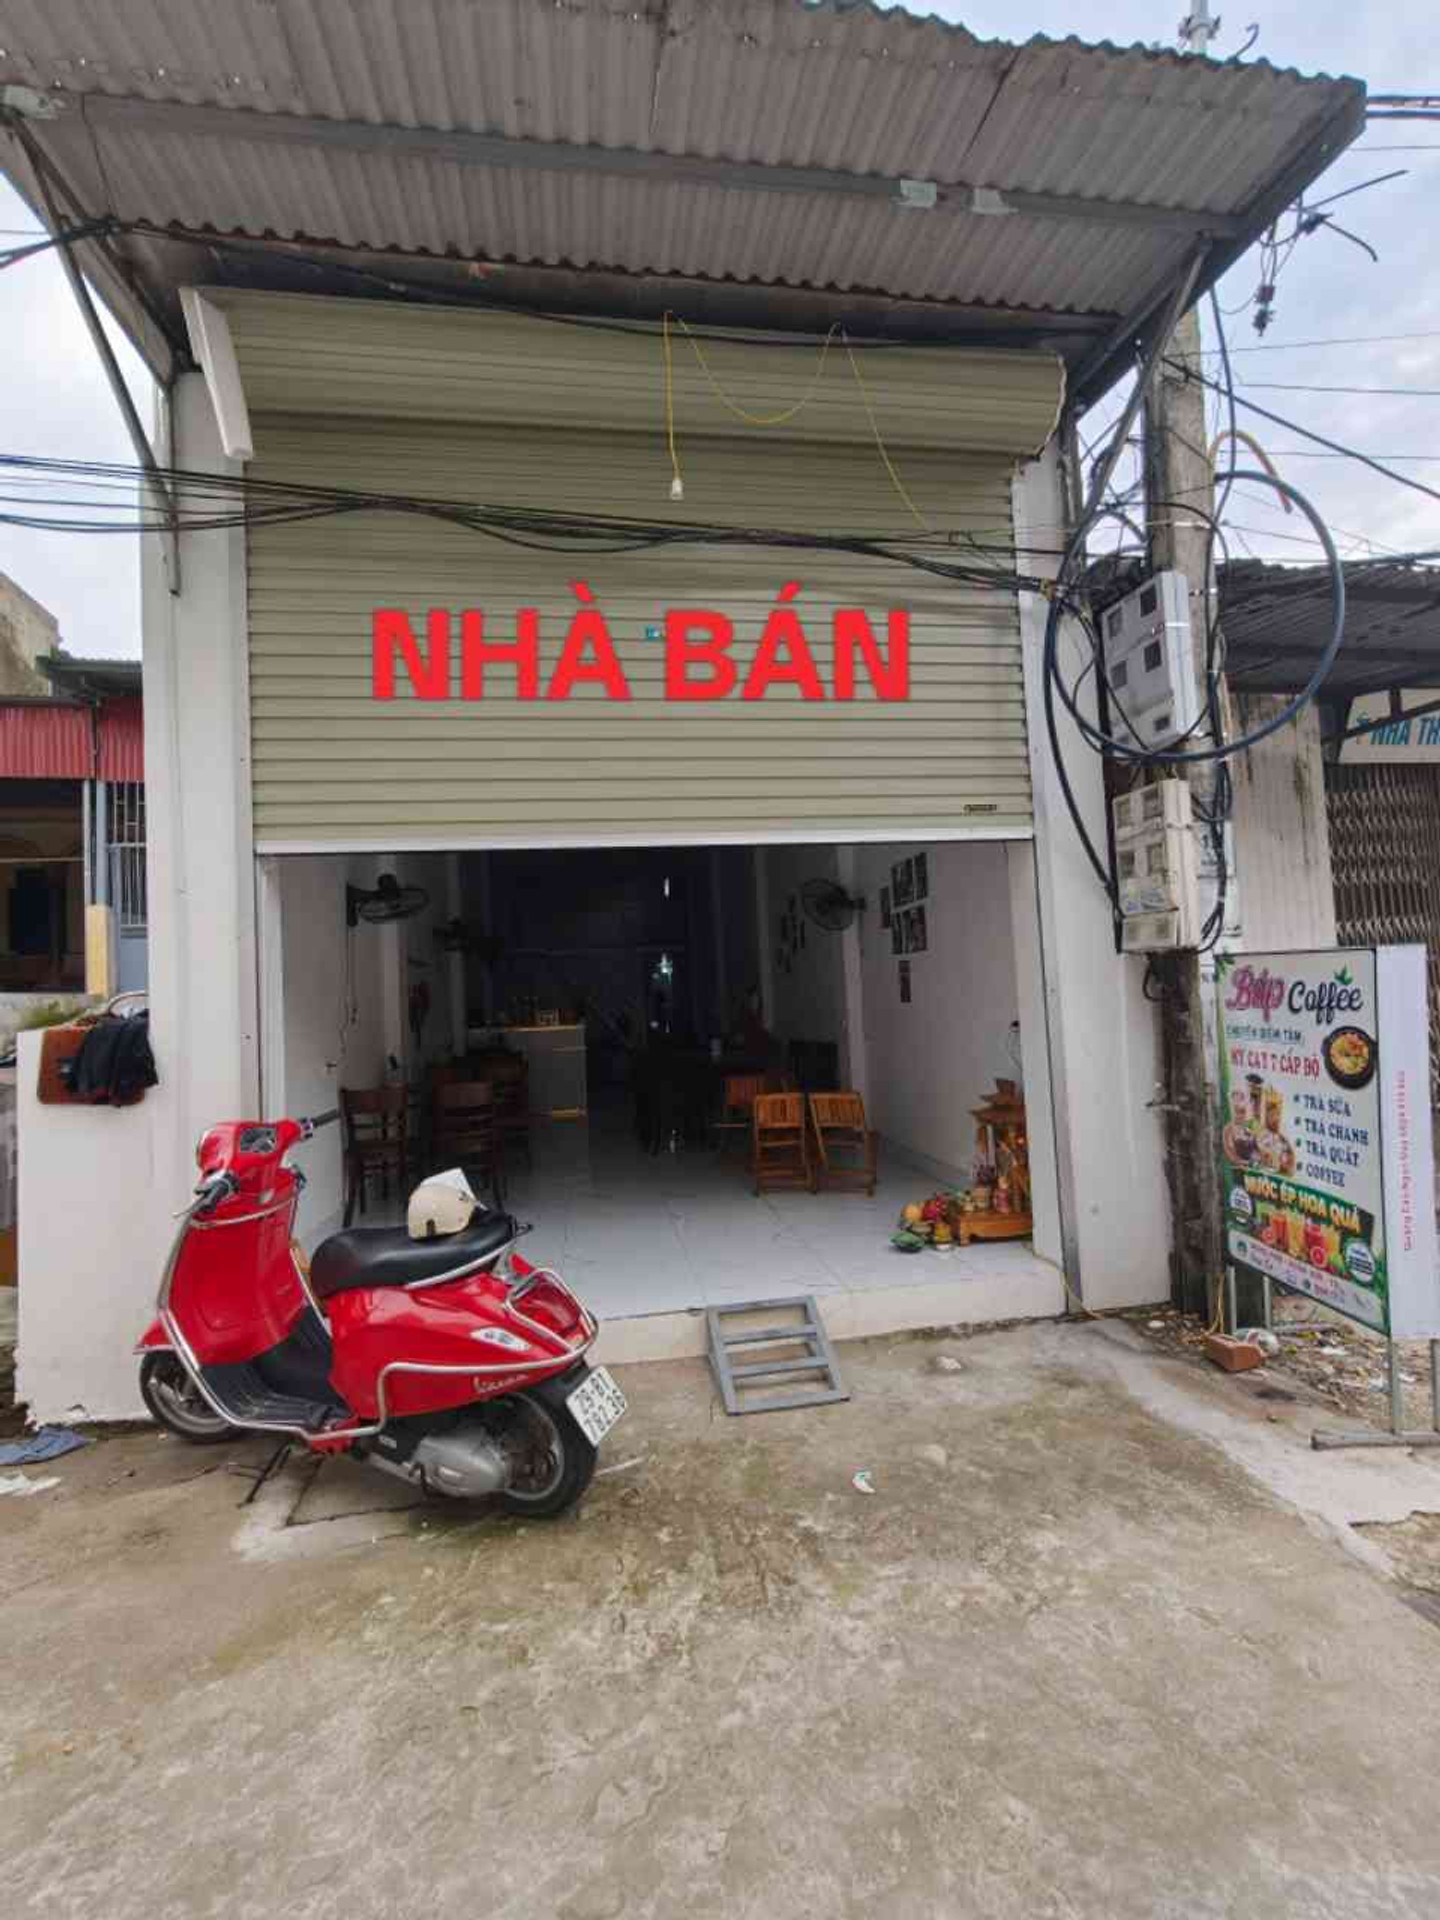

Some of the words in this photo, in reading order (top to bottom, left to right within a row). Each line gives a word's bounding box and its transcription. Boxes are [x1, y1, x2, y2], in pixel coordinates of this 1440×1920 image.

[1288, 980, 1364, 1025] Coffee
[1328, 1122, 1369, 1146] CHANH
[1306, 1162, 1345, 1187] COFFEE
[1298, 1189, 1328, 1218] HOA
